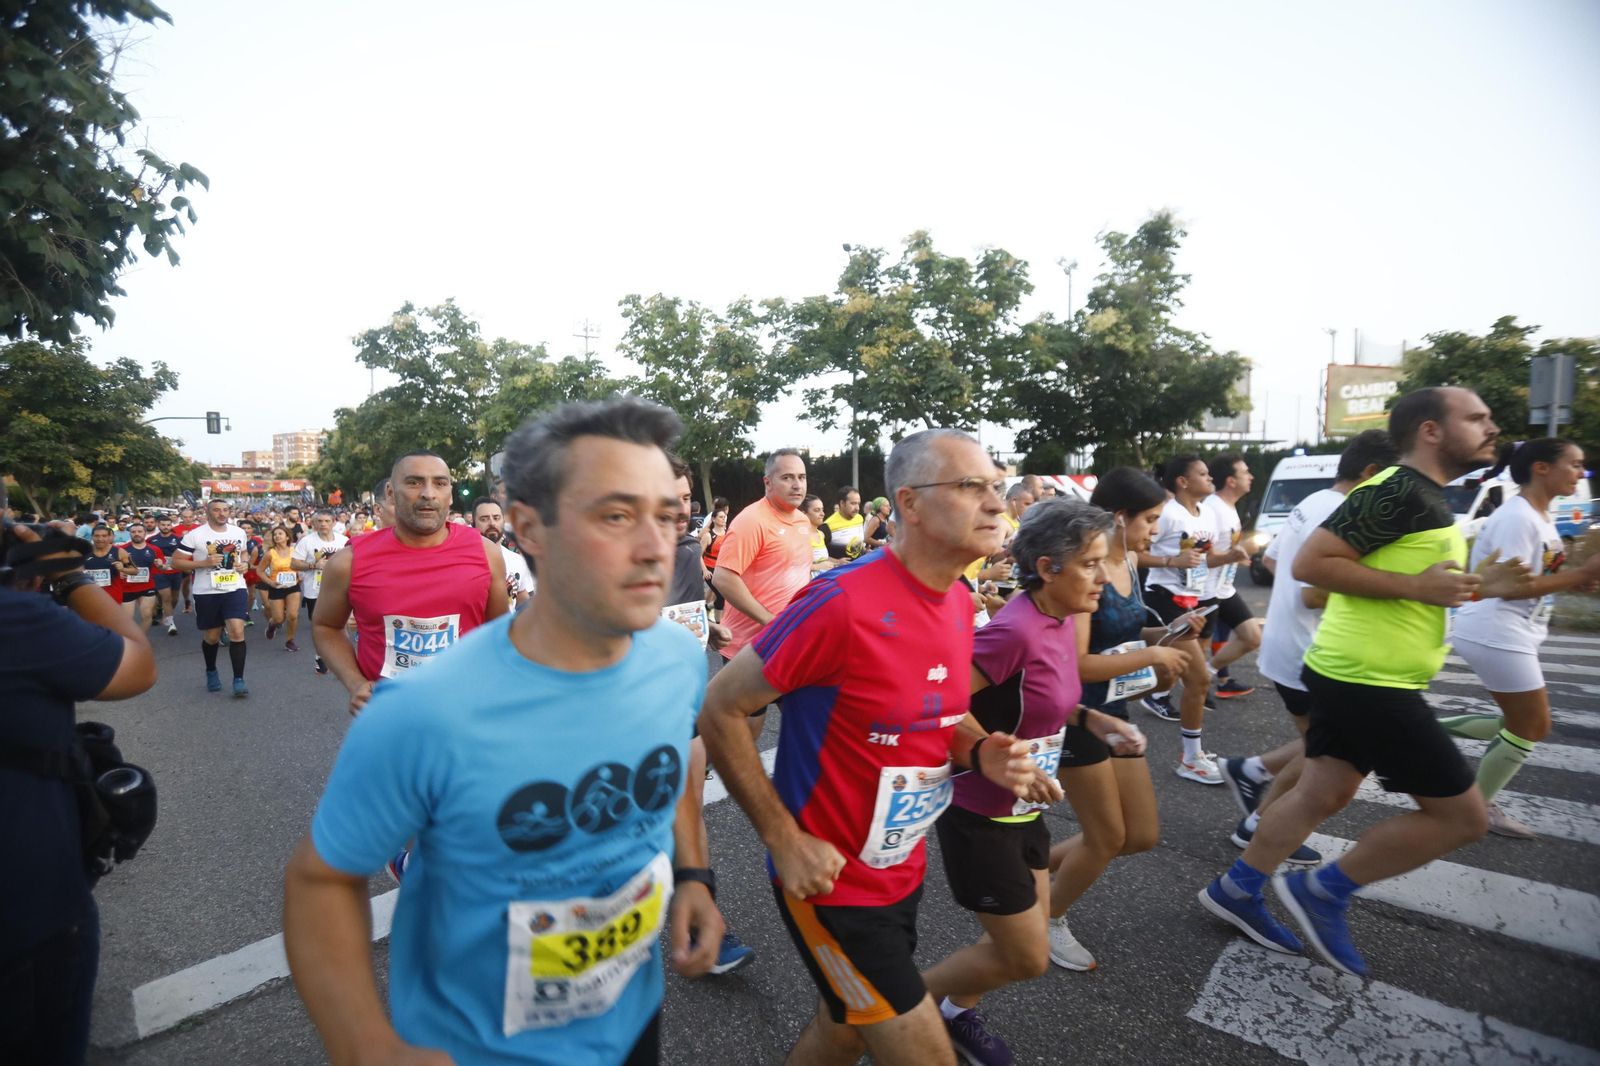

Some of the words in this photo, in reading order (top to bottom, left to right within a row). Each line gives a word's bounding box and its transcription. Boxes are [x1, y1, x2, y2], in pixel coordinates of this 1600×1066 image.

[1341, 381, 1397, 398] CAMBIO
[219, 575, 234, 583] 967
[398, 631, 450, 653] 2044
[867, 732, 900, 747] 21K
